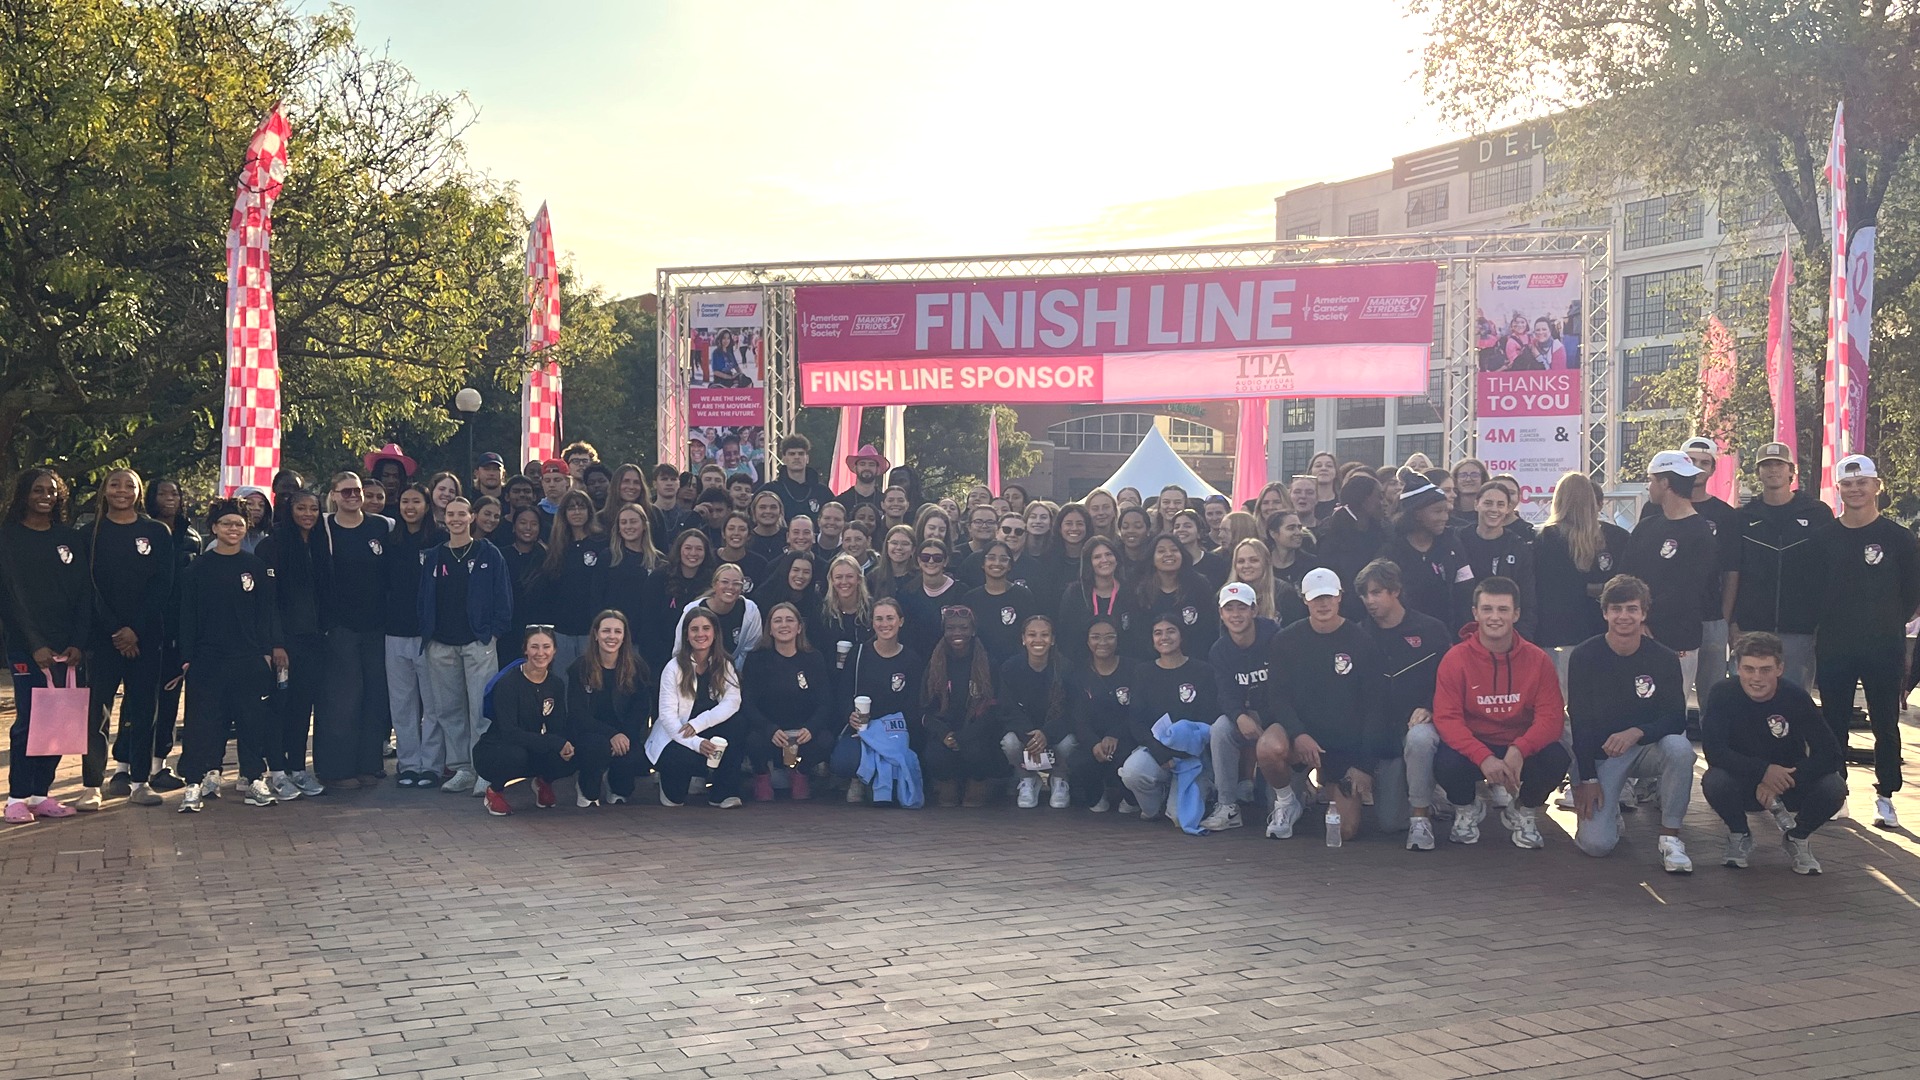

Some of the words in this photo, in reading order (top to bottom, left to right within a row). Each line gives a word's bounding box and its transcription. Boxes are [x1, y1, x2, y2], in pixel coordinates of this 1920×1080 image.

[1313, 296, 1360, 305] American
[1368, 298, 1410, 306] MAKING
[1312, 305, 1348, 313] Cancer
[1366, 305, 1406, 313] STRIDES
[810, 314, 849, 322] American
[915, 287, 1131, 351] FINISH
[1146, 279, 1297, 345] LINE
[1312, 312, 1350, 321] Society
[810, 329, 841, 338] Society
[1236, 353, 1295, 379] ITA
[810, 370, 894, 392] FINISH
[900, 367, 954, 391] LINE
[960, 365, 1095, 389] SPONSOR
[1235, 384, 1295, 392] SOLUTIONS
[1486, 375, 1570, 393] THANKS
[1486, 395, 1518, 411] TO
[1522, 394, 1570, 410] YOU
[1484, 428, 1516, 443] 4M
[1554, 426, 1569, 442] &
[1484, 460, 1517, 471] 150K
[1476, 693, 1521, 705] DAYTON
[1485, 706, 1513, 714] GOLF
